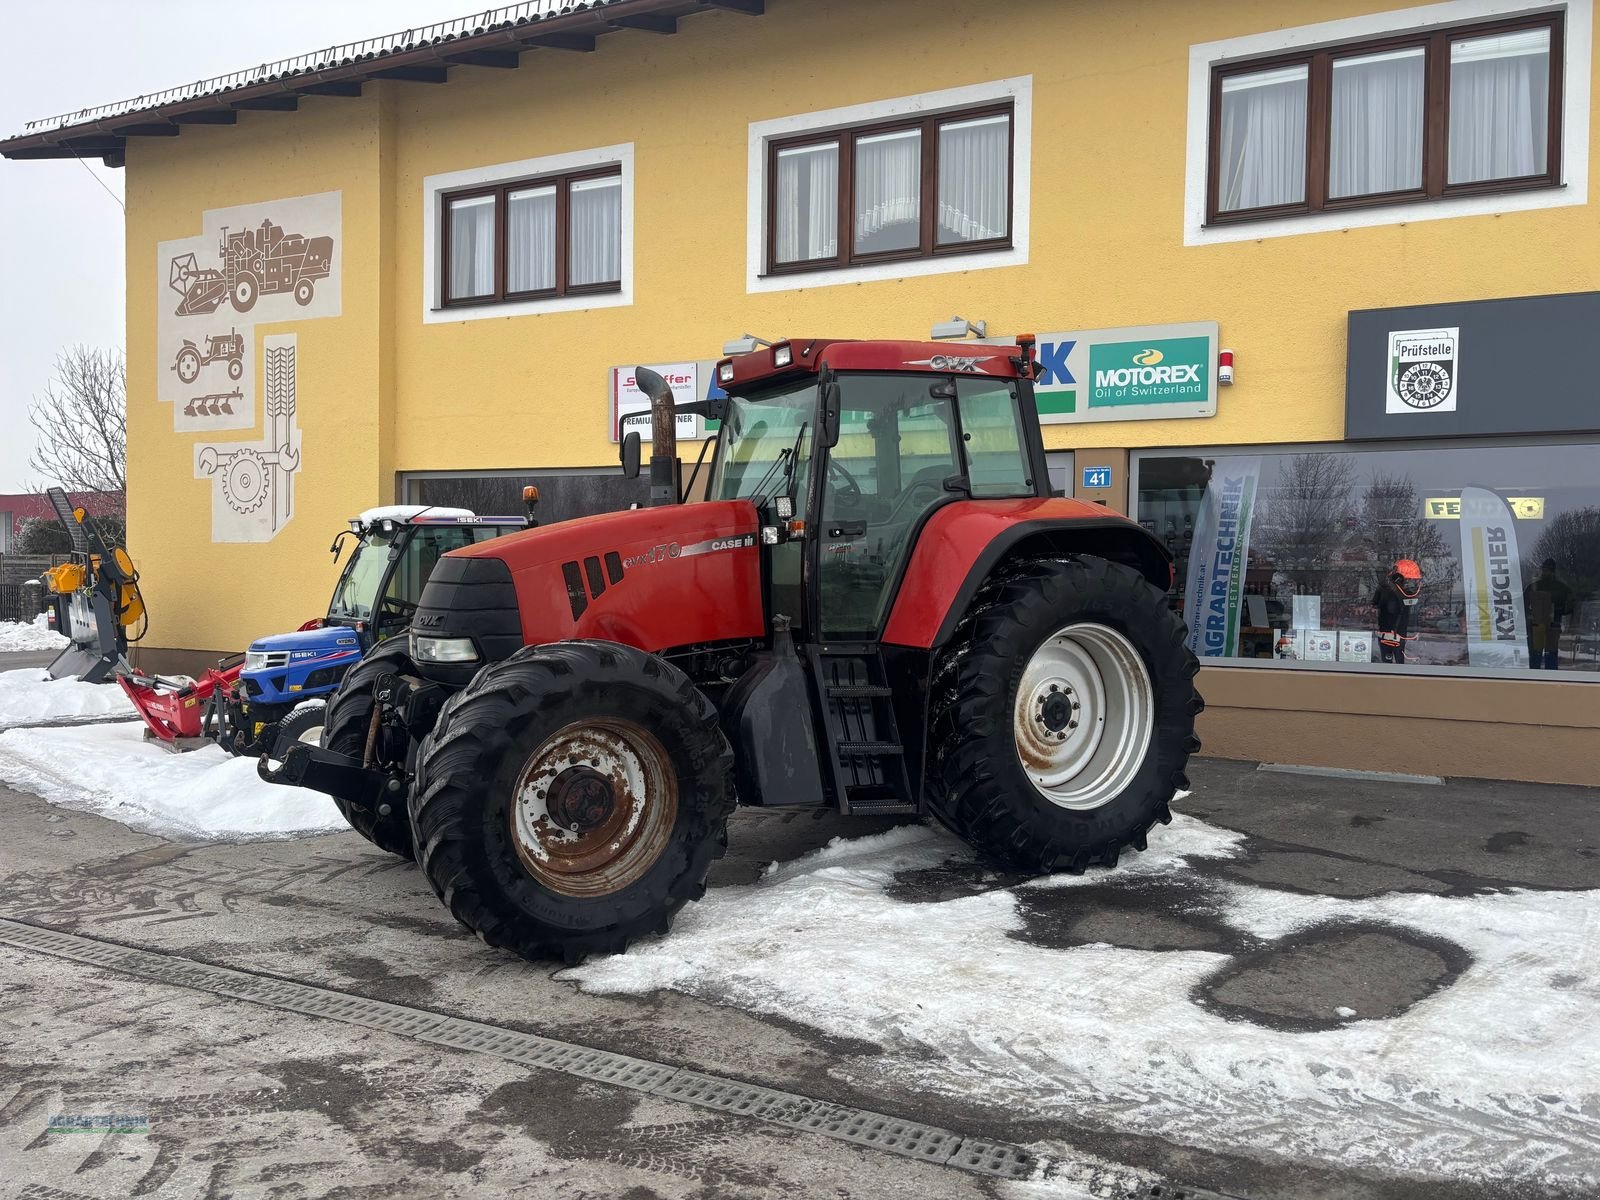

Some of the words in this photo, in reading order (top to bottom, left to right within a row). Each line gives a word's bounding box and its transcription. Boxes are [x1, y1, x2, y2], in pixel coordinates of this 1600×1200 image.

[1401, 344, 1451, 357] Prüfstelle
[929, 355, 983, 373] CVX
[623, 374, 692, 387] Sffer
[1096, 364, 1201, 388] MOTOREX
[1095, 388, 1111, 398] Oil
[1115, 386, 1127, 397] of
[1131, 383, 1201, 396] Switzerland
[623, 416, 652, 426] PREMIU
[1090, 472, 1105, 485] 41
[711, 538, 742, 551] CASE
[1204, 476, 1244, 657] AGRARTECHNIK
[292, 651, 317, 659] ISEKI
